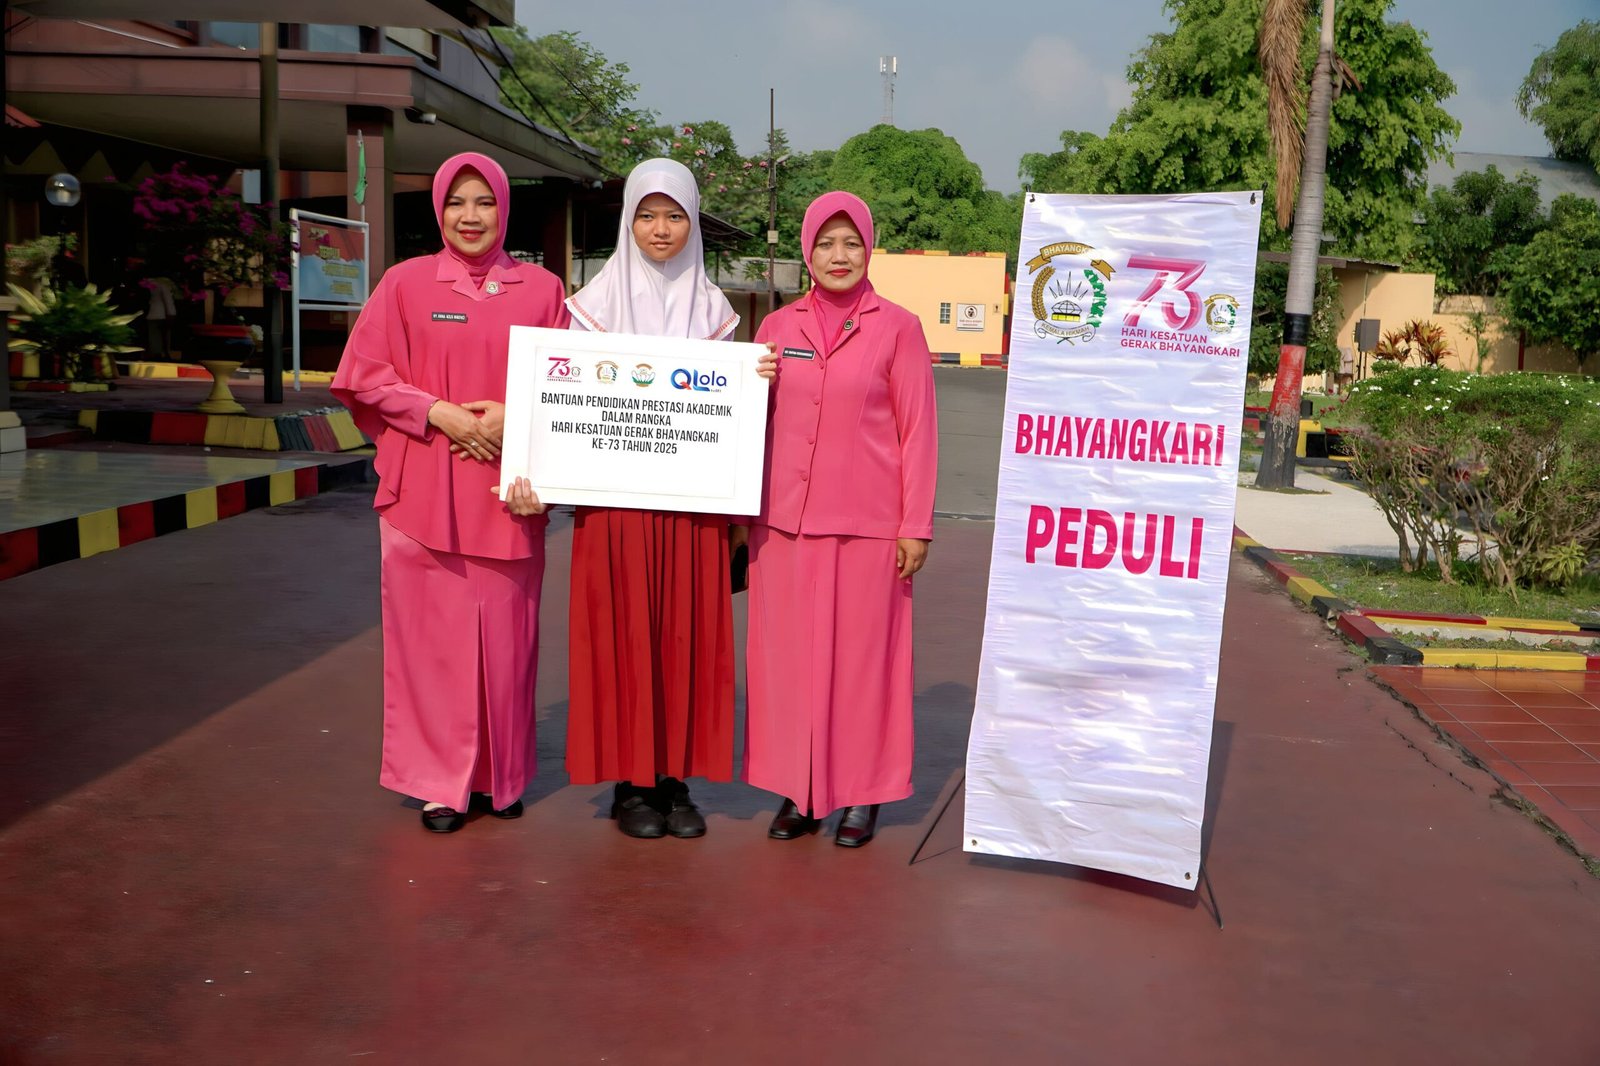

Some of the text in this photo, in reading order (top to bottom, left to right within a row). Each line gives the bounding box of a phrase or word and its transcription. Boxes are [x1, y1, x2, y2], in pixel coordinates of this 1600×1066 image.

[1043, 244, 1091, 256] BHAYANGK
[1123, 254, 1206, 331] 73
[1041, 323, 1065, 336] KEMALA
[1121, 327, 1207, 344] HARI KESATUAN
[1120, 339, 1240, 357] GERAK BHAYANGKARI
[547, 356, 571, 377] 73
[541, 392, 732, 417] BANTUAN PENDIDIKAN PRESTASI AKADEMIK
[602, 410, 671, 426] DALAM RANGKA
[551, 421, 719, 443] HARI KESATUAN GERAK BHAYANGKARI
[1015, 413, 1225, 466] BHAYANGKARI
[592, 437, 677, 454] KE-73 TAHUN 2025
[1025, 504, 1204, 579] PEDULI
